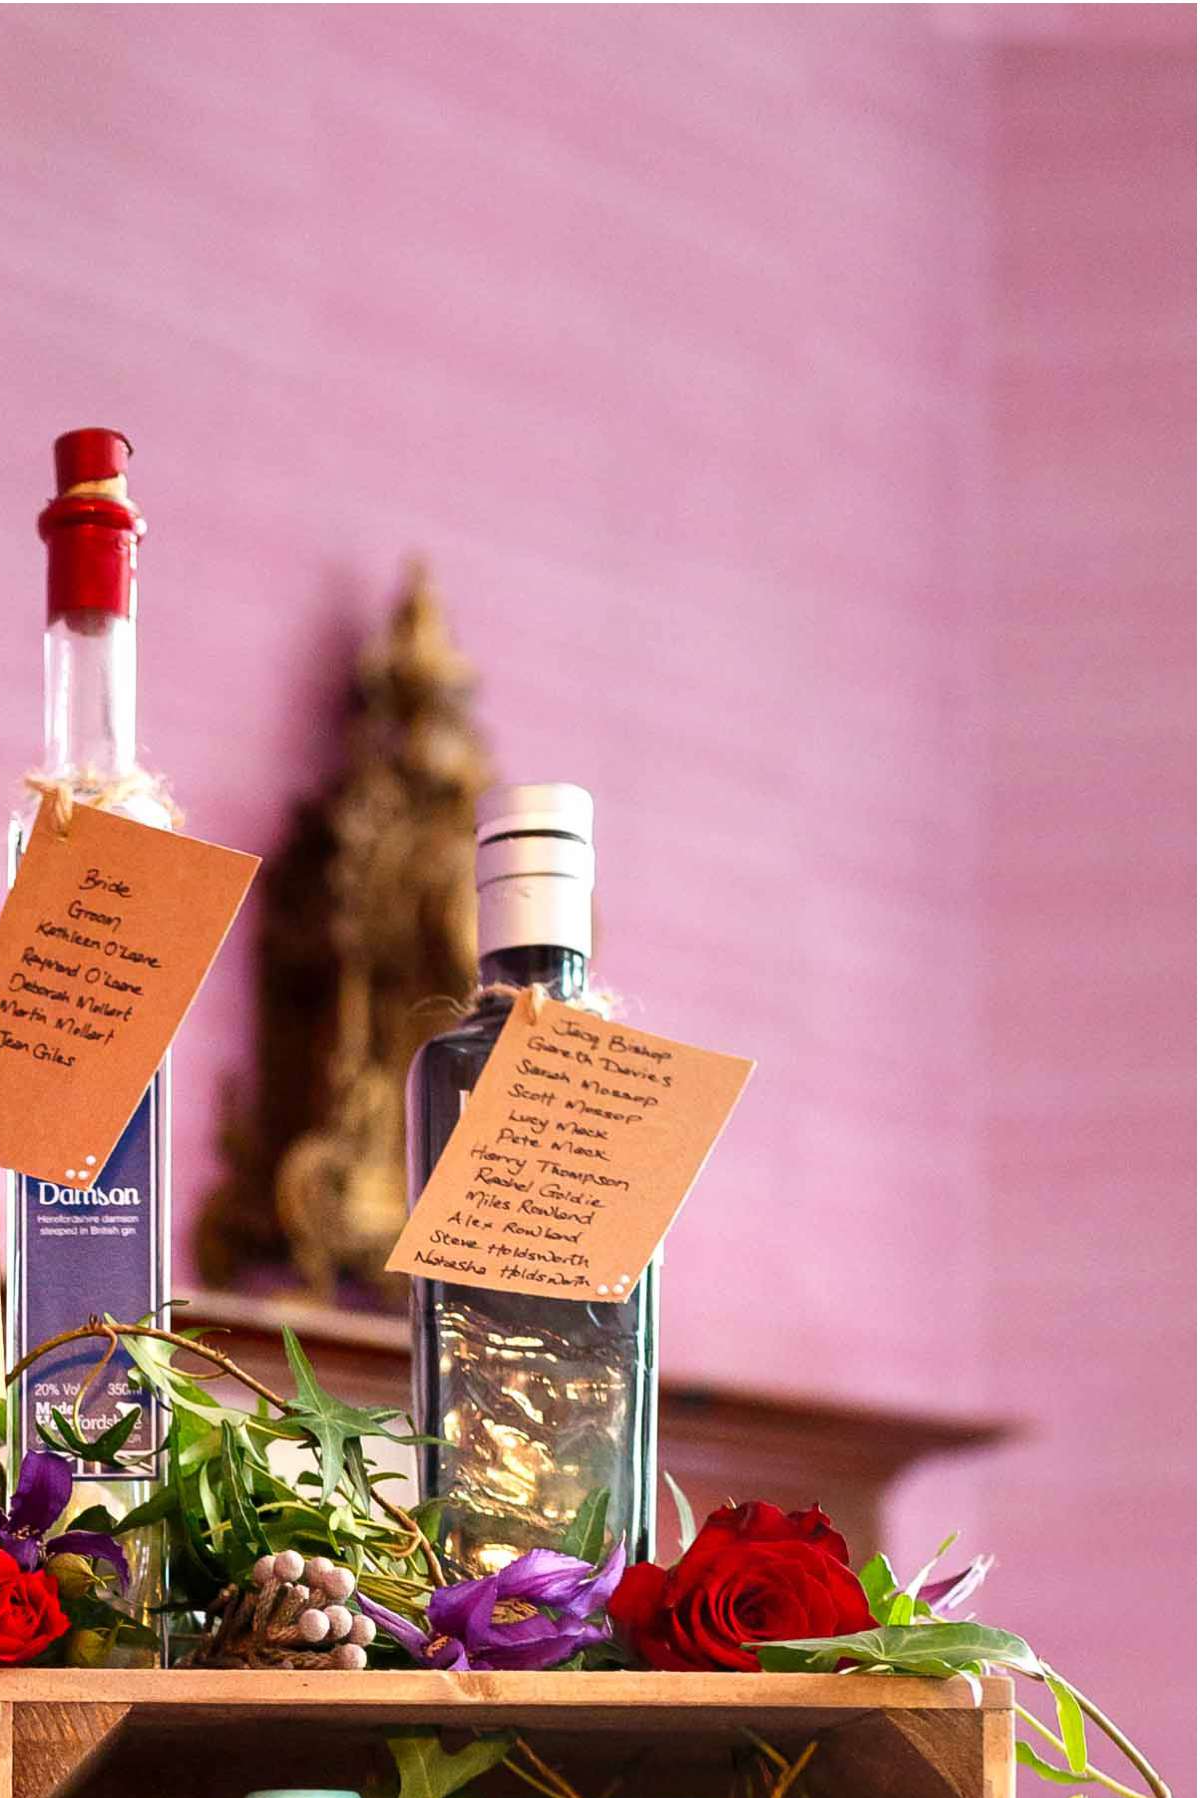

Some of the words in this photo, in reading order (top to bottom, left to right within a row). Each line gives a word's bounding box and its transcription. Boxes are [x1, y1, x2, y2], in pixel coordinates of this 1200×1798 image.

[79, 869, 131, 898] Bride
[68, 900, 121, 932] Groom
[35, 922, 100, 949] Kathleen
[21, 946, 81, 977] Raymond
[9, 973, 69, 1002] Deborah
[0, 1000, 46, 1024] Martin
[33, 1043, 76, 1067] Giles
[516, 1059, 570, 1083] Sarah
[507, 1083, 556, 1106] Scott
[536, 1160, 629, 1191] Thompson
[37, 1182, 141, 1206] Damson
[517, 1199, 595, 1225] Rowland
[502, 1222, 583, 1244] Rowland
[429, 1229, 482, 1249] Steve
[488, 1244, 589, 1268] Holdsworth
[500, 1265, 591, 1287] Holdsworth
[34, 1383, 60, 1396] 20%
[62, 1382, 81, 1396] Vol
